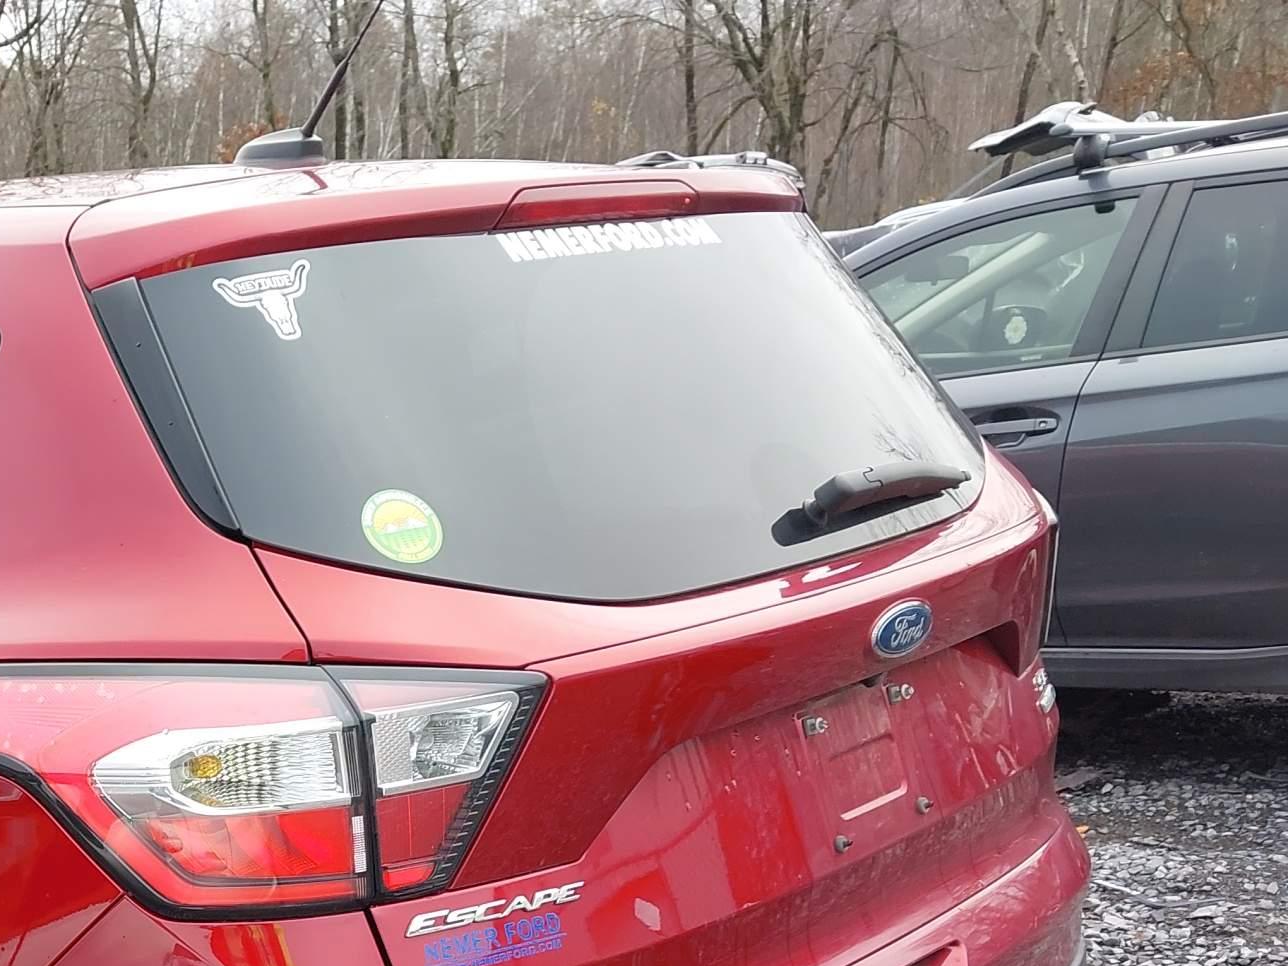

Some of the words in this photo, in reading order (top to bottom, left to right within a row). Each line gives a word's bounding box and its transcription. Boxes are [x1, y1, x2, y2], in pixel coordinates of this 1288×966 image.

[496, 218, 722, 262] NEMERFORD.COM
[889, 613, 926, 648] Ford
[405, 881, 585, 939] ESCAPE
[424, 926, 502, 961] NEMER
[504, 912, 562, 945] FORD
